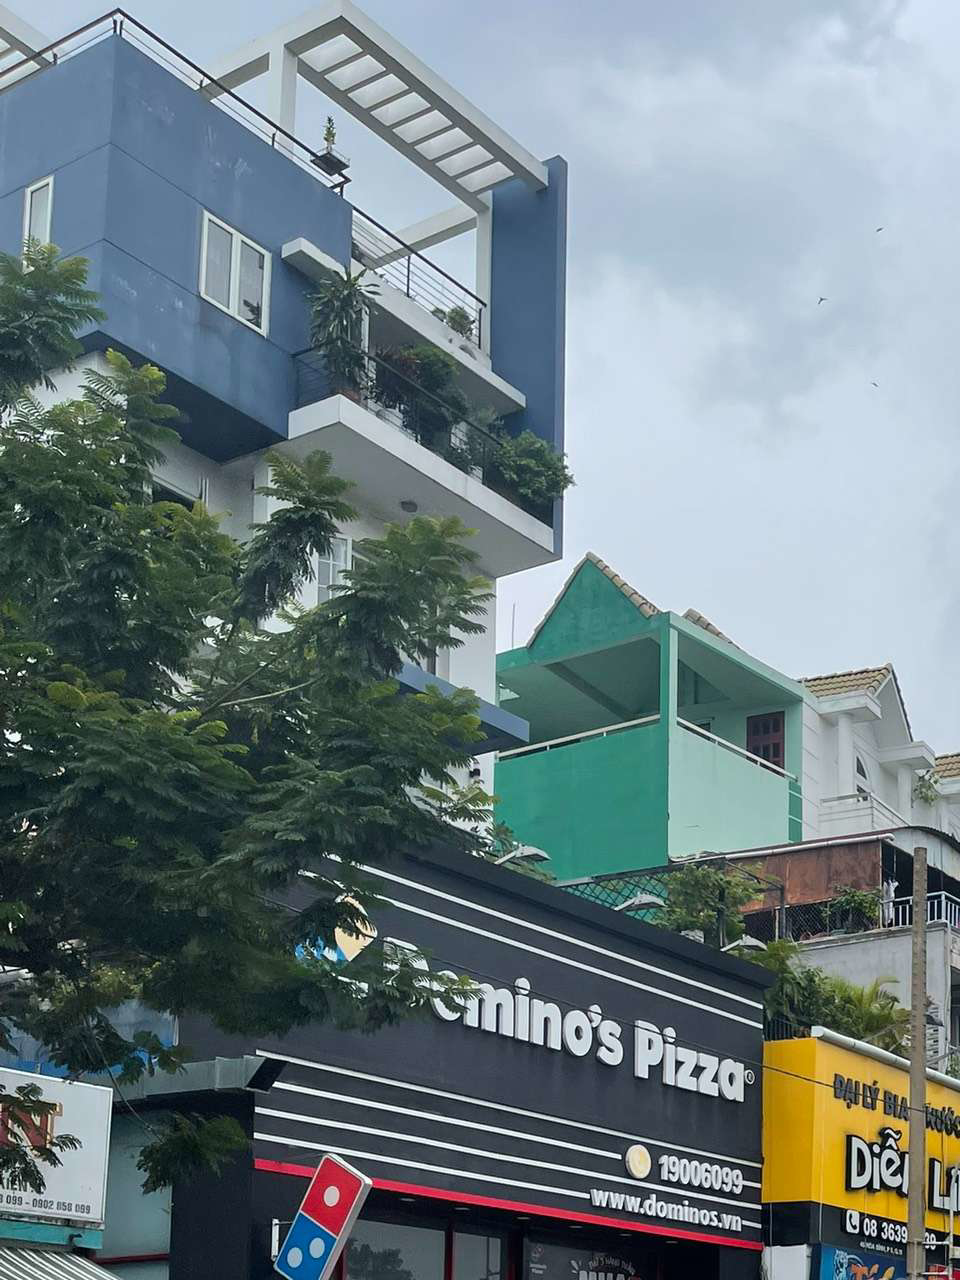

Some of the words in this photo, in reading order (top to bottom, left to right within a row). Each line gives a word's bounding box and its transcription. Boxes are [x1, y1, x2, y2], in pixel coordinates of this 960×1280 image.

[883, 1090, 910, 1121] BIA
[658, 1154, 744, 1195] 19006099
[590, 1188, 743, 1232] www.dominos.vn
[863, 1217, 878, 1237] 08
[881, 1221, 908, 1244] 3639
